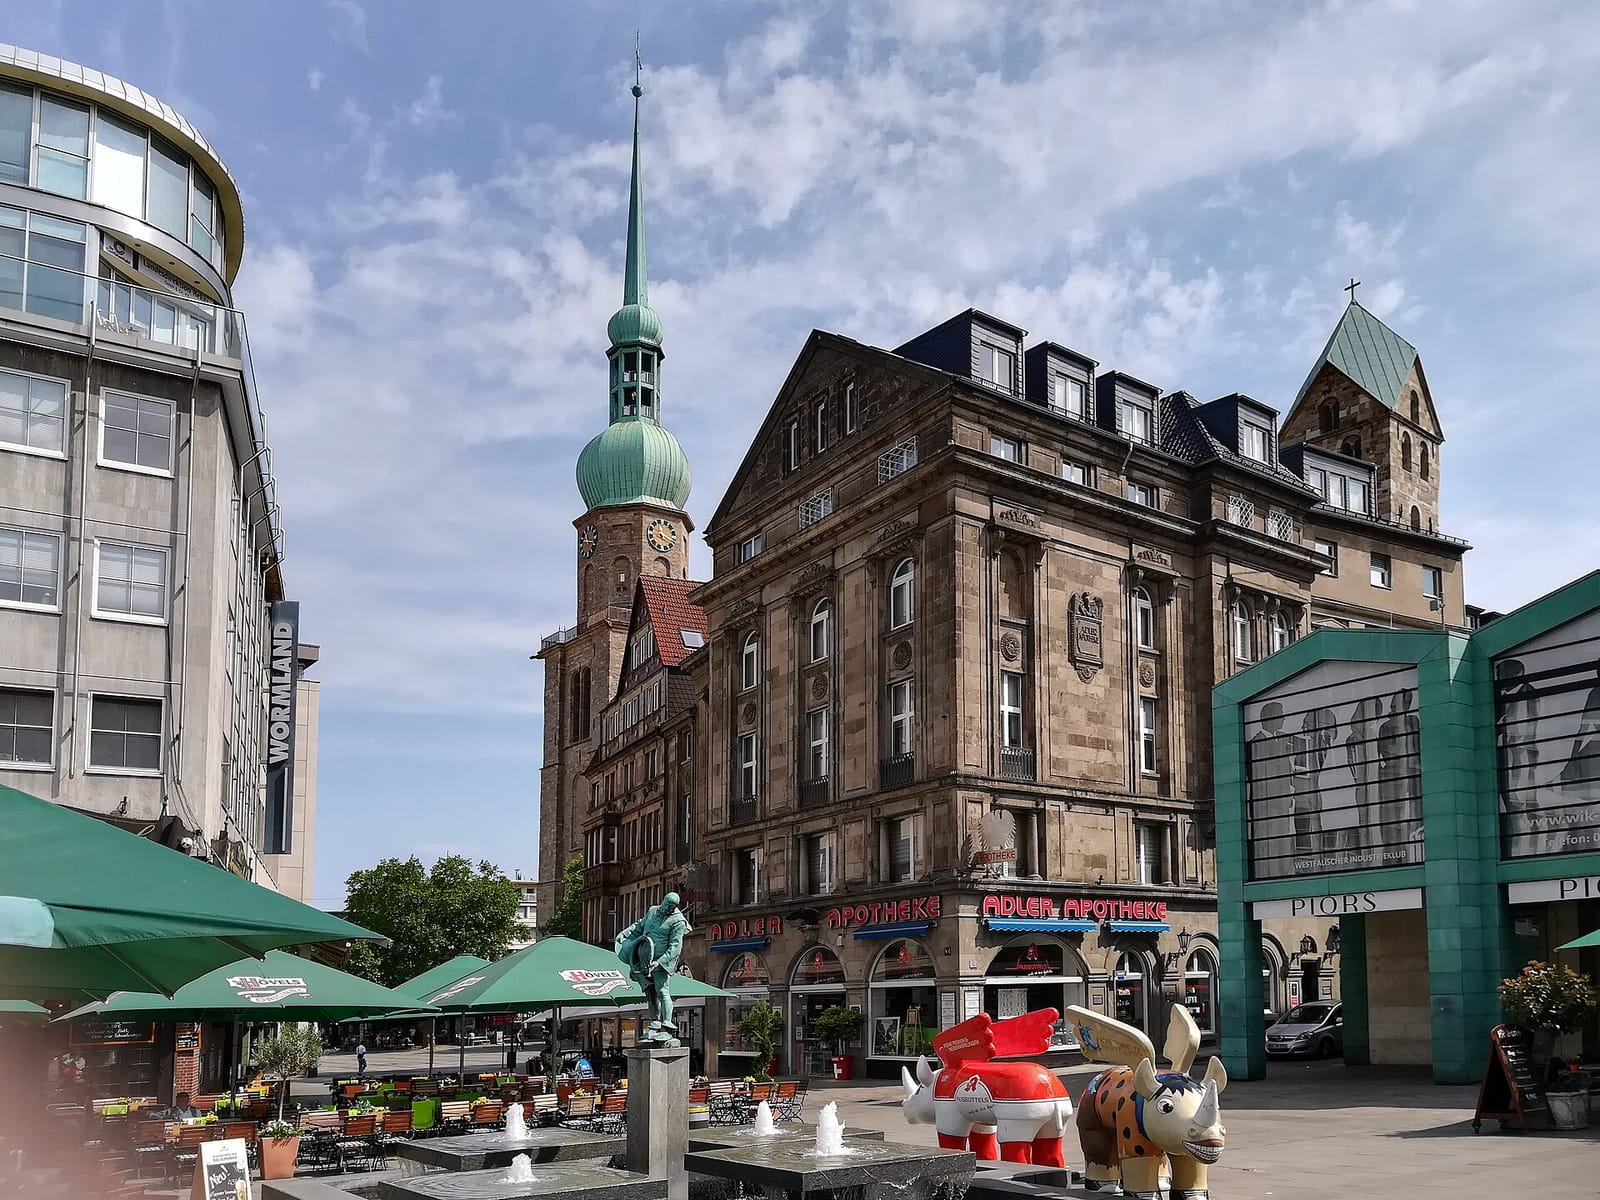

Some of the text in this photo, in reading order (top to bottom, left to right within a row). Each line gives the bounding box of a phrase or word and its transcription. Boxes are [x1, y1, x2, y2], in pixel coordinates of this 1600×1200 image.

[269, 622, 293, 764] WORMLAND
[976, 850, 1016, 863] APOTHEKE
[1560, 877, 1600, 899] PI
[982, 894, 1168, 919] ADLER APOTHEKE
[1291, 892, 1377, 916] PIORS
[709, 895, 942, 941] ADLER APOTHEKE
[209, 1164, 231, 1189] Neu!
